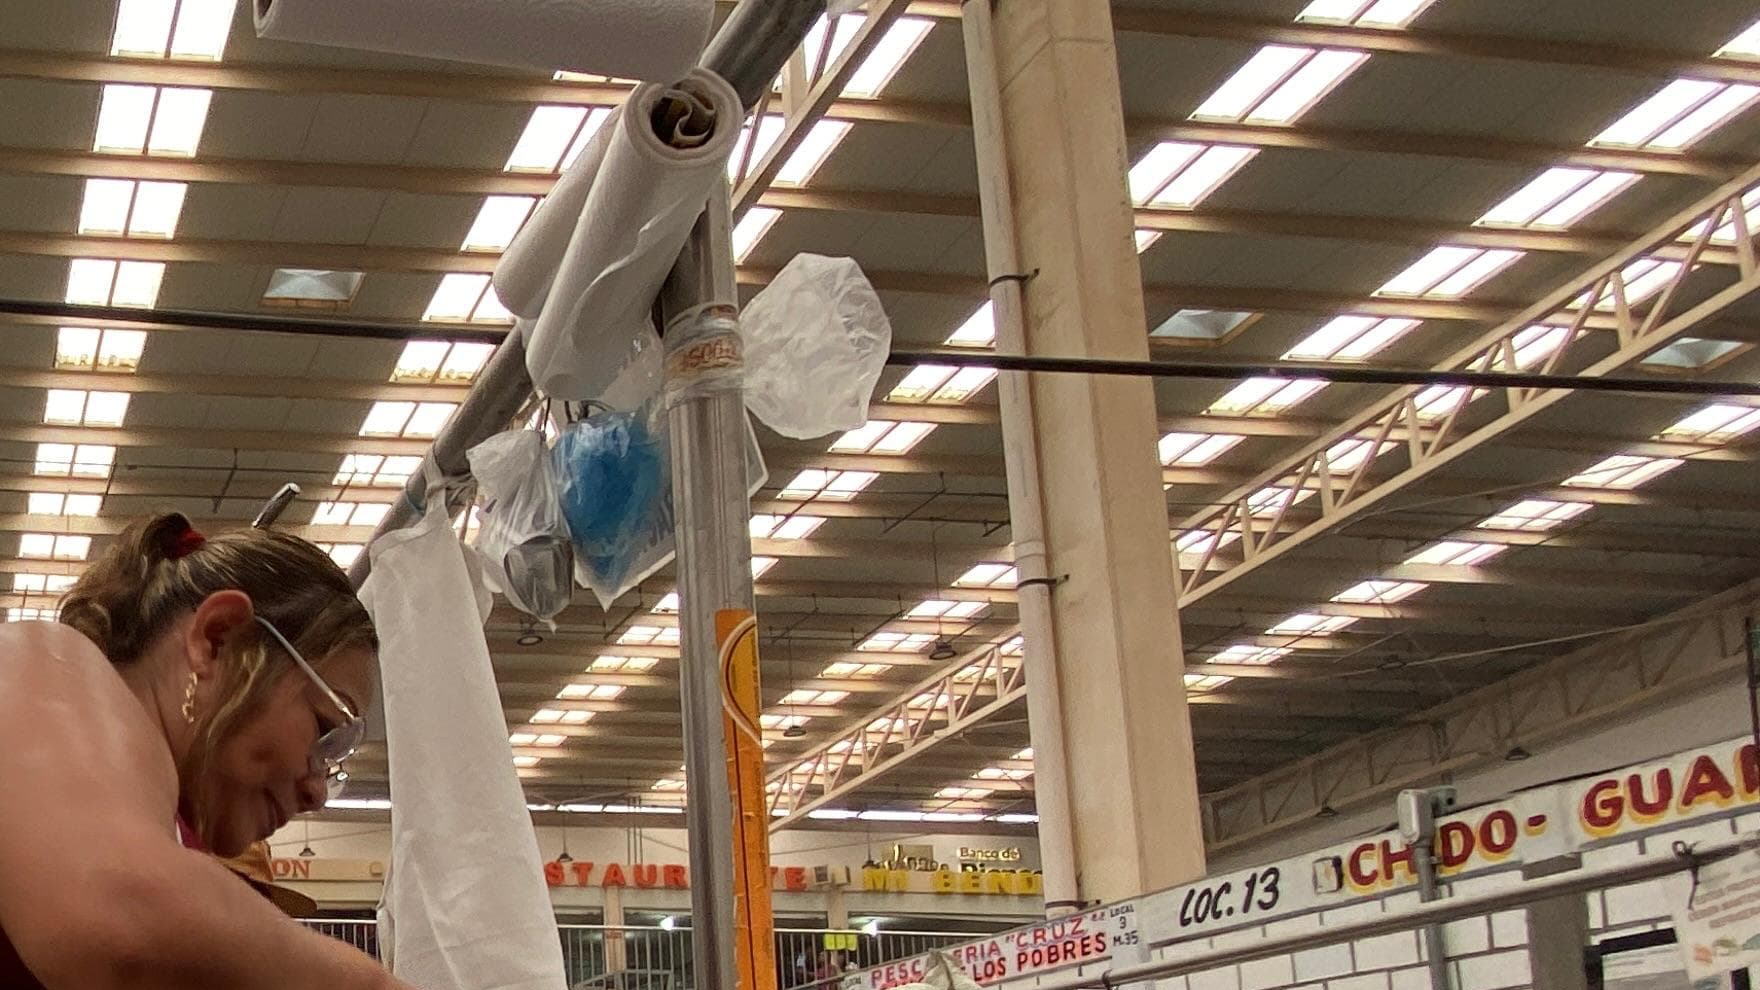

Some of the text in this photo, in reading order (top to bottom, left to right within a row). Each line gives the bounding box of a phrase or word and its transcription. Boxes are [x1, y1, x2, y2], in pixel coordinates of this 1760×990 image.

[959, 847, 998, 860] Banco
[1179, 867, 1280, 927] LOC. 13
[1119, 915, 1127, 929] 3
[871, 940, 1002, 988] PESCERIA
[973, 932, 1107, 982] LOS POBRES
